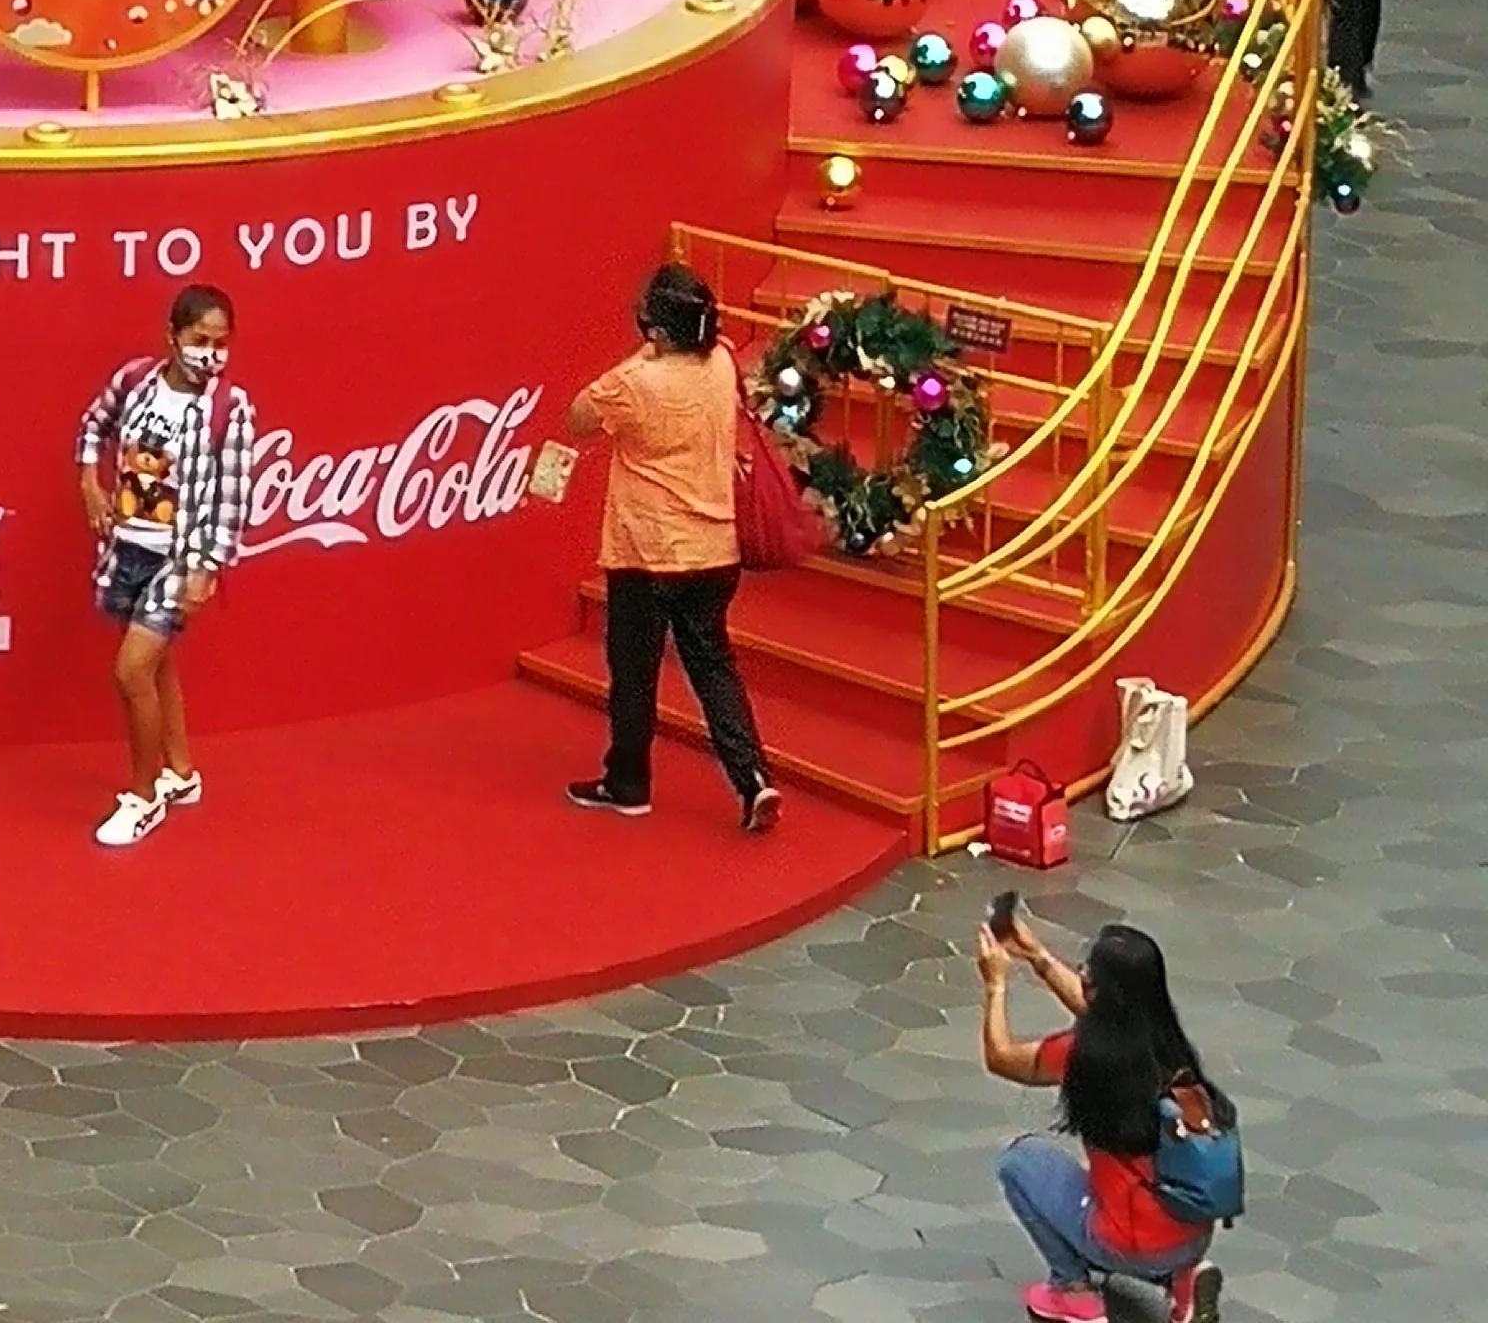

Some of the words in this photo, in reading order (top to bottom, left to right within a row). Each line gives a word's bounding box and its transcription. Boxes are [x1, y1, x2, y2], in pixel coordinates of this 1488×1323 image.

[113, 227, 202, 278] TO
[237, 209, 373, 270] YOU
[406, 193, 479, 251] BY
